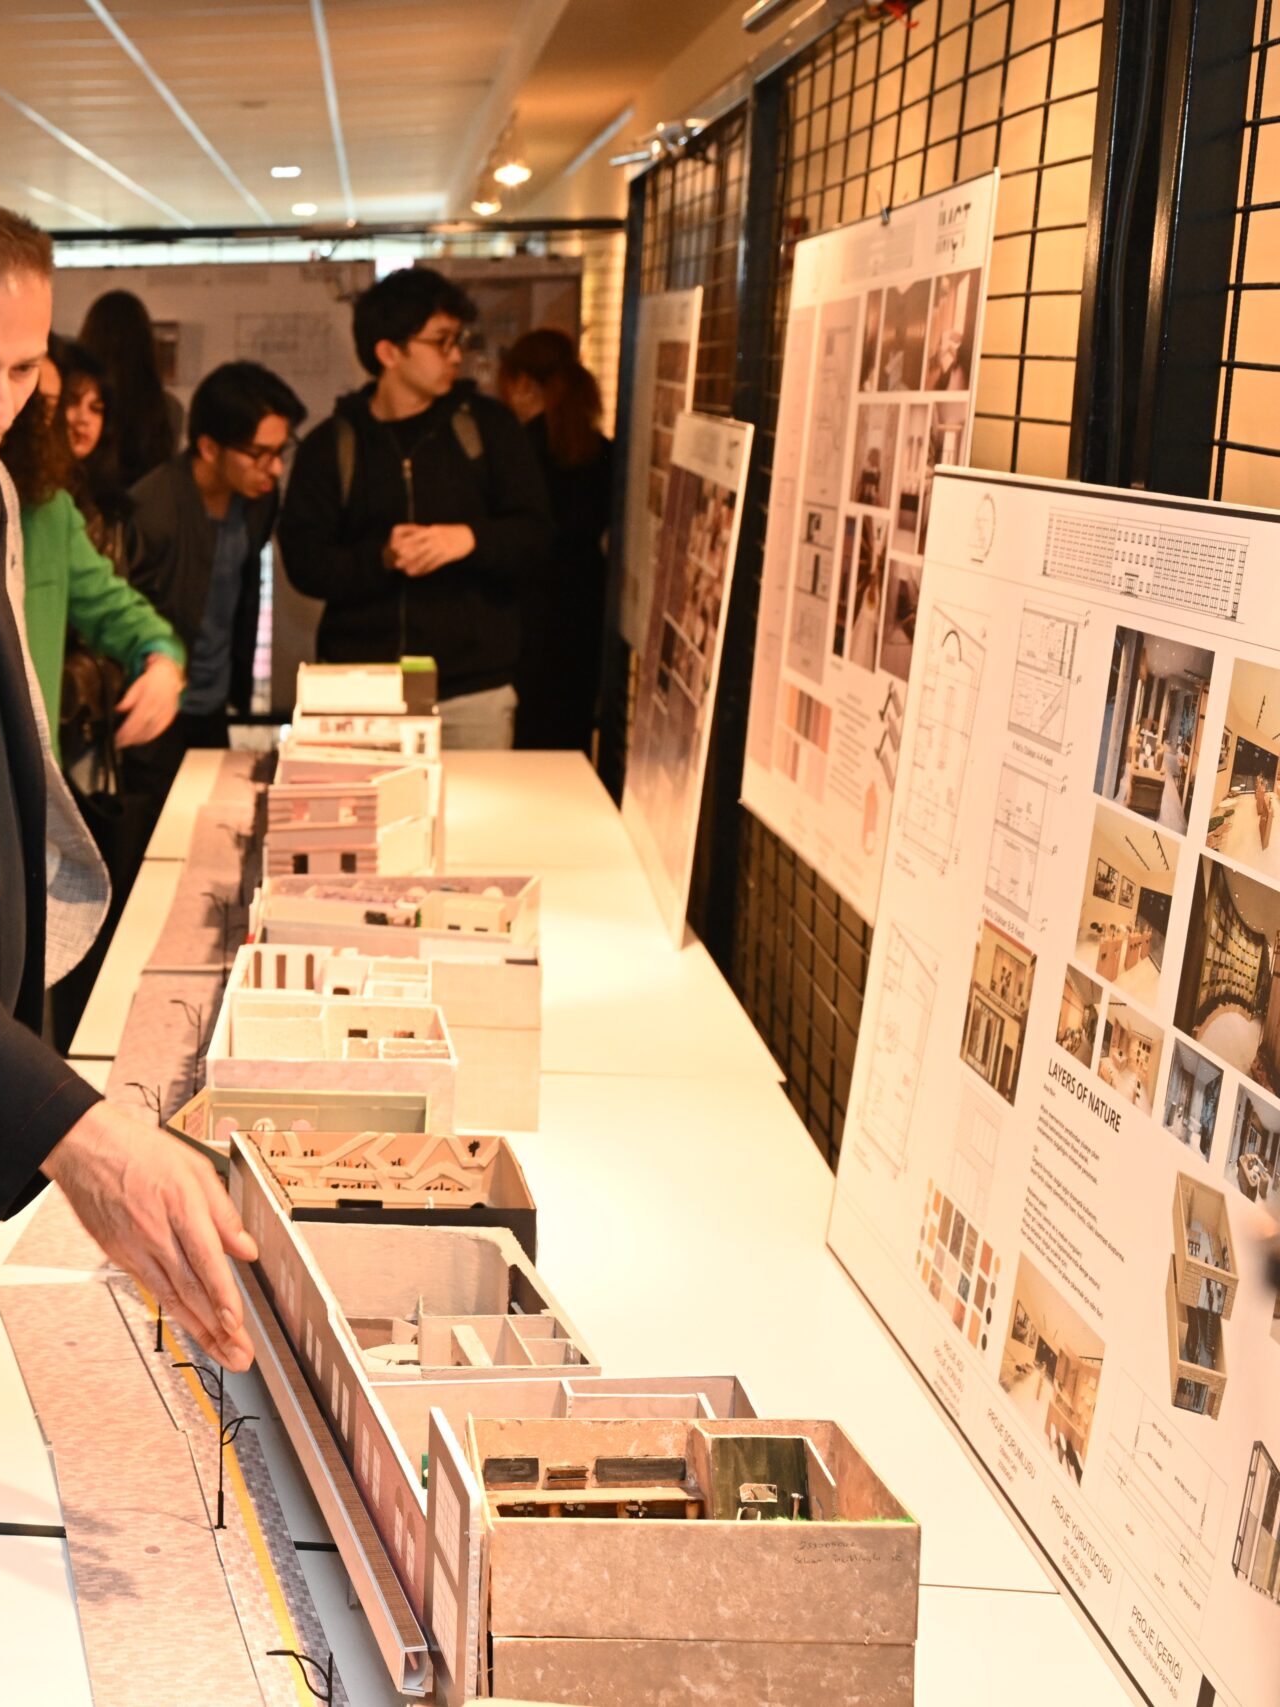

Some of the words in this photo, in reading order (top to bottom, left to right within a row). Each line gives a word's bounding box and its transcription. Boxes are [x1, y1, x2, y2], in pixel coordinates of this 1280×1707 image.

[1048, 1058, 1076, 1094] LAYERS
[1076, 1082, 1089, 1103] OF
[1088, 1091, 1122, 1133] NATURE
[1051, 1494, 1071, 1529] PROJE
[1132, 1605, 1155, 1646] PROJE
